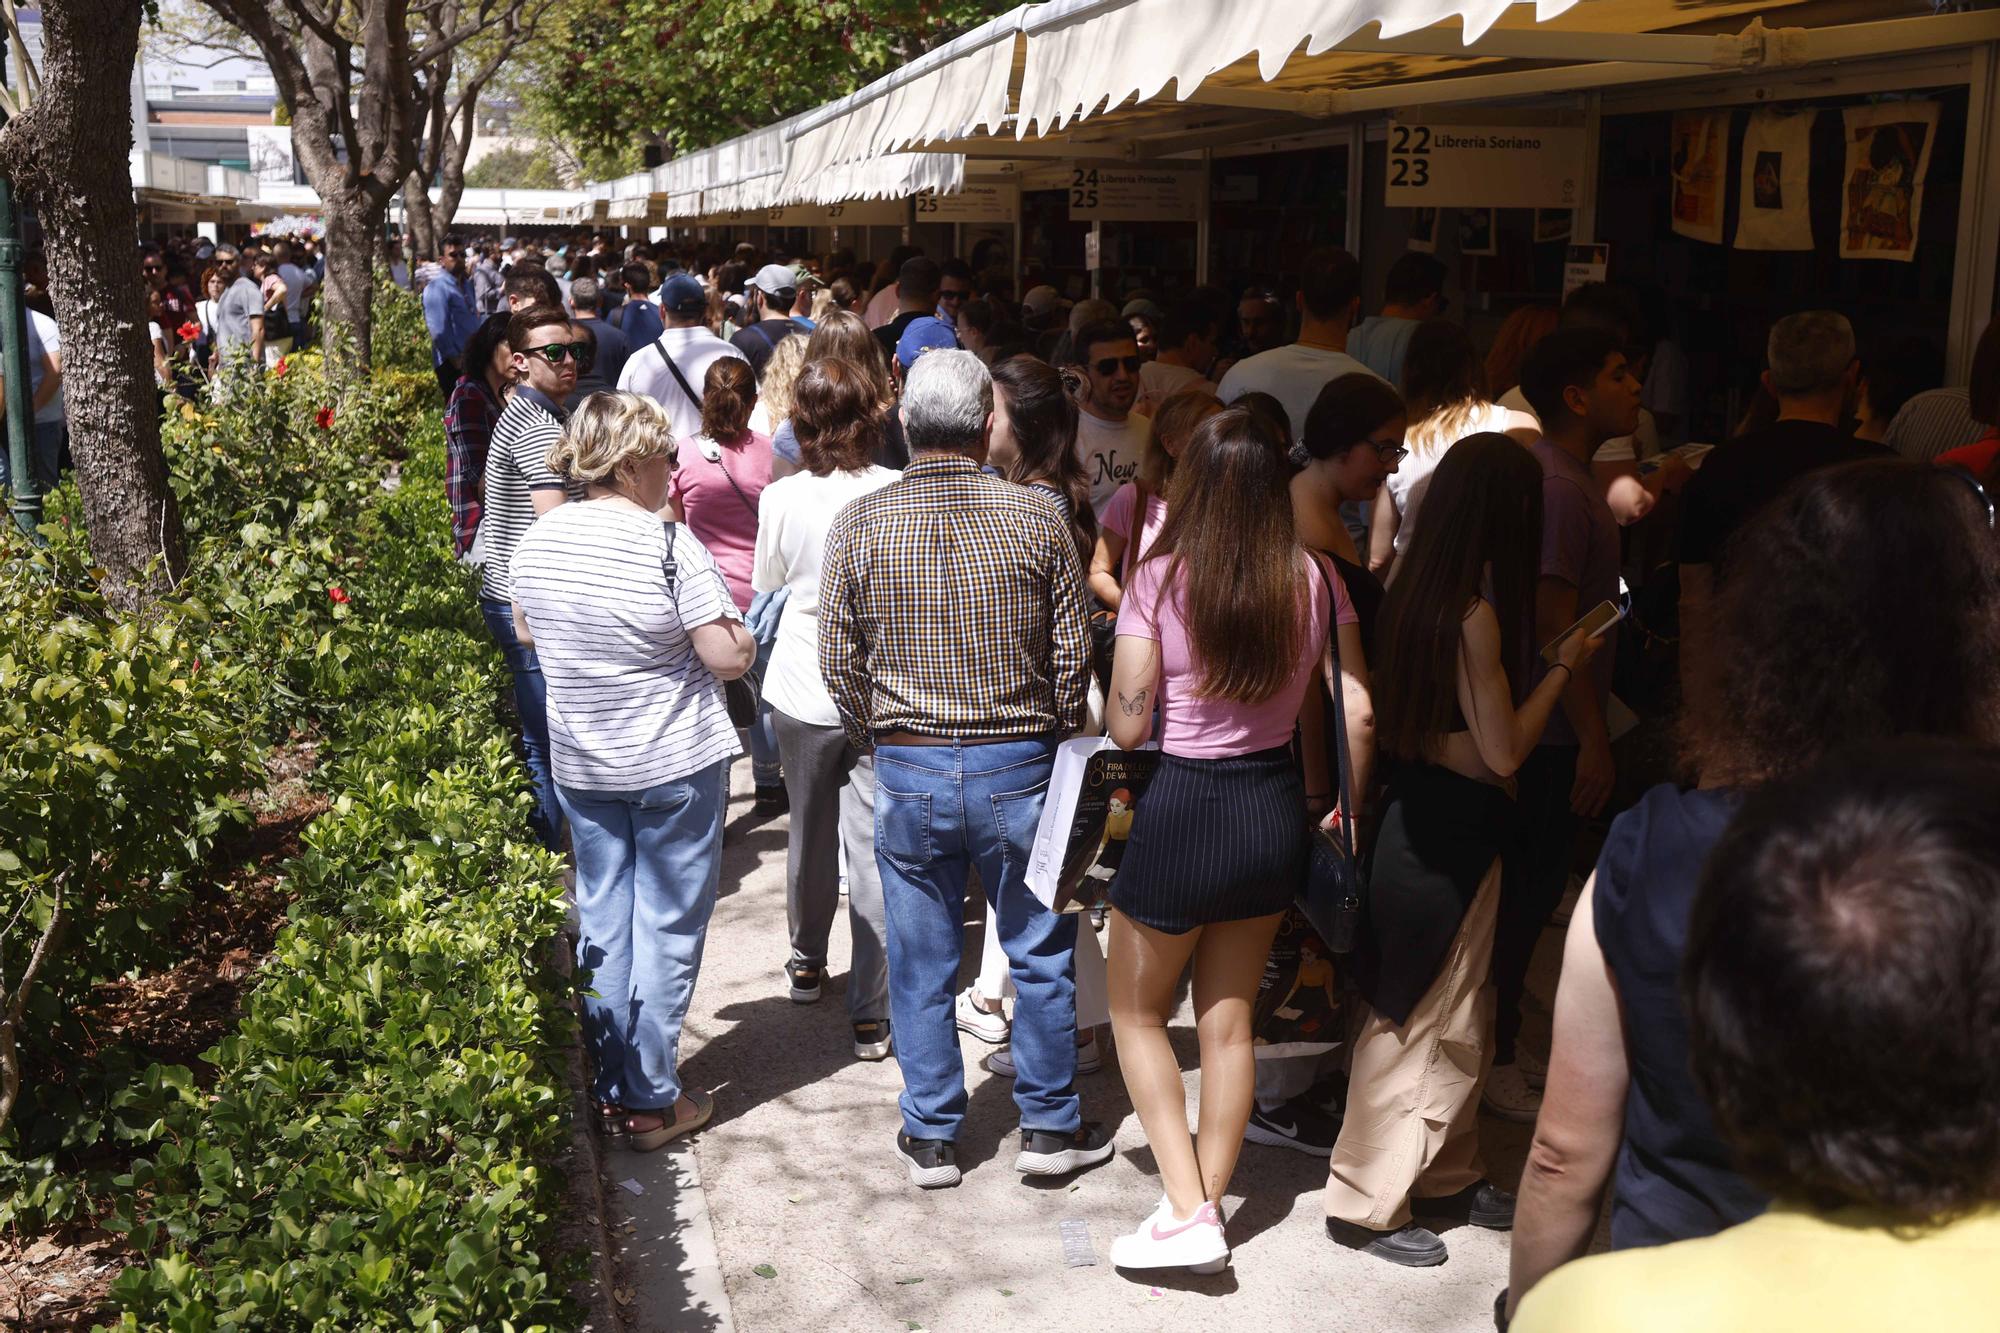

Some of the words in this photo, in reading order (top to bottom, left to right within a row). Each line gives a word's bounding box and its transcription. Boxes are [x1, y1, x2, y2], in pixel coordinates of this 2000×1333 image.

[1391, 126, 1431, 154] 22
[1489, 135, 1542, 149] Soriano
[1072, 169, 1098, 188] 24
[1390, 158, 1429, 187] 23
[918, 198, 938, 212] 25
[1072, 190, 1098, 208] 25
[1106, 763, 1124, 772] FIRA
[1106, 771, 1117, 780] DE
